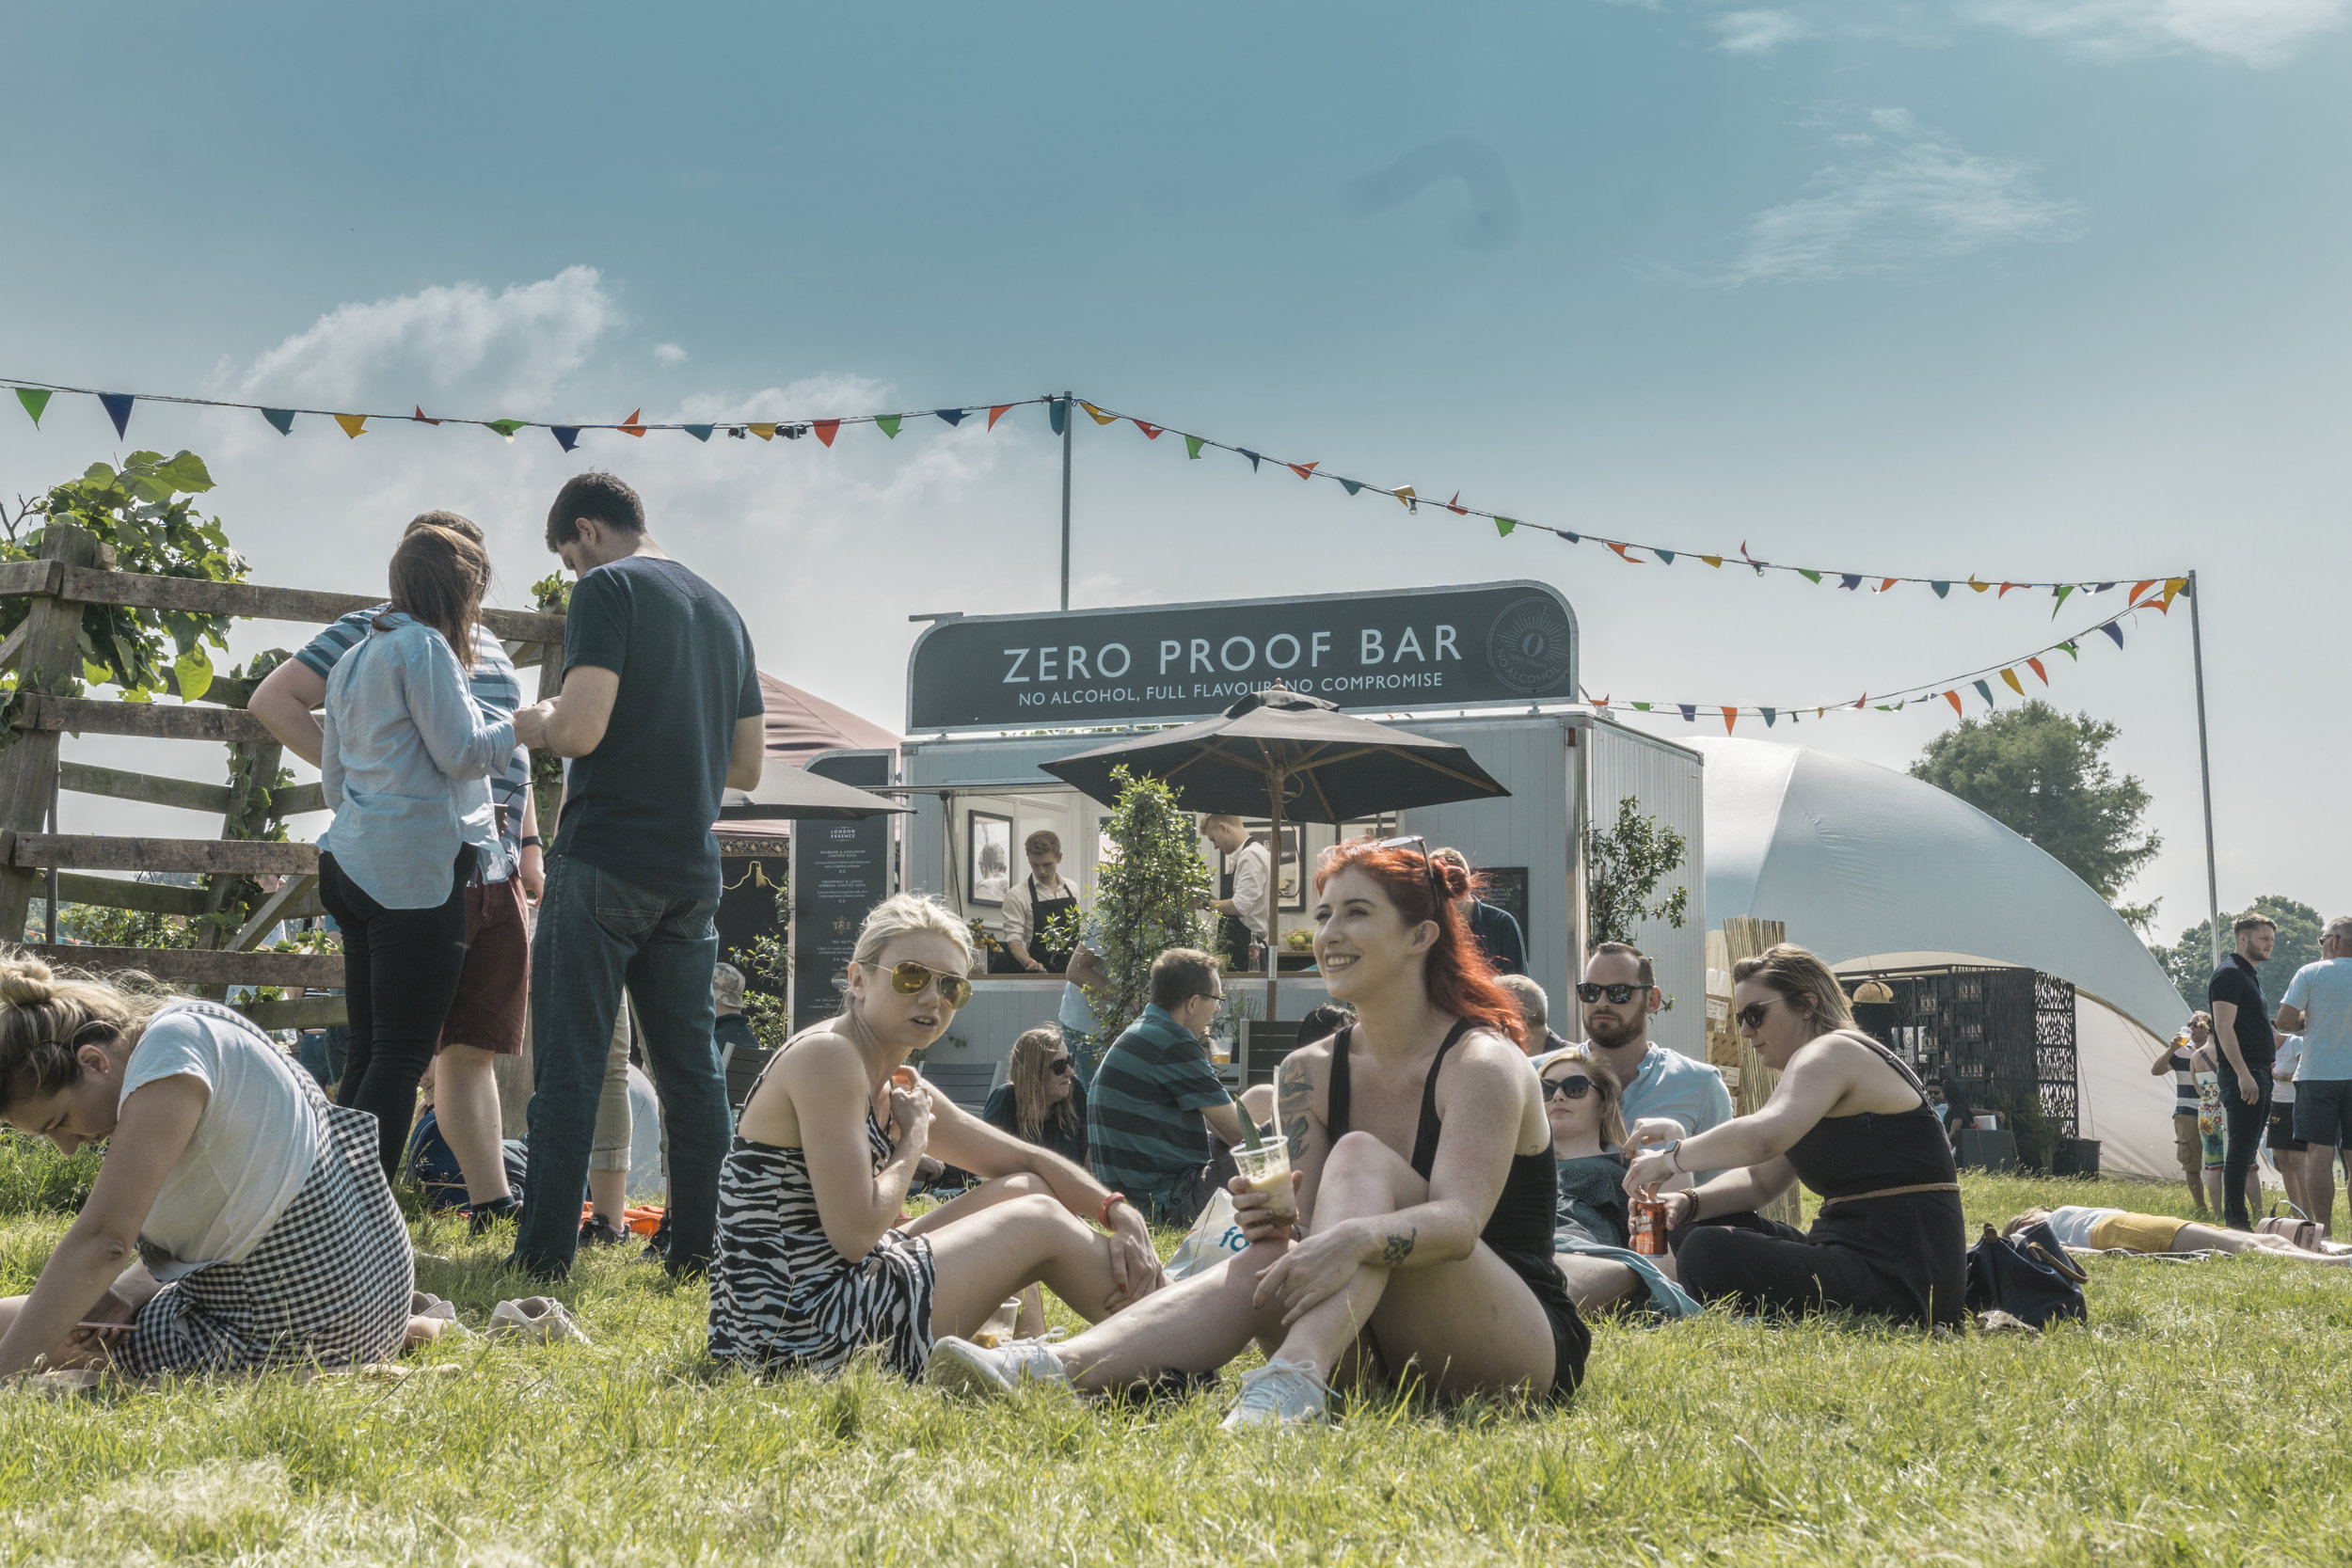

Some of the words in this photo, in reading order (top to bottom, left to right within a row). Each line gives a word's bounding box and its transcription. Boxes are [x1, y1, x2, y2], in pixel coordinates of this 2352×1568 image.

[1002, 642, 1131, 684] ZERO
[1159, 631, 1331, 675] PROOF
[1360, 625, 1462, 665] BAR
[1496, 649, 1509, 667] NO
[1504, 666, 1561, 684] ALCOHOL
[1019, 691, 1045, 706] NO
[1050, 688, 1140, 705] ALCOHOL,
[1146, 685, 1186, 700] FULL
[1194, 680, 1272, 698] FLAVOUR
[1285, 678, 1313, 693] NO
[1321, 672, 1442, 691] COMPROMISE
